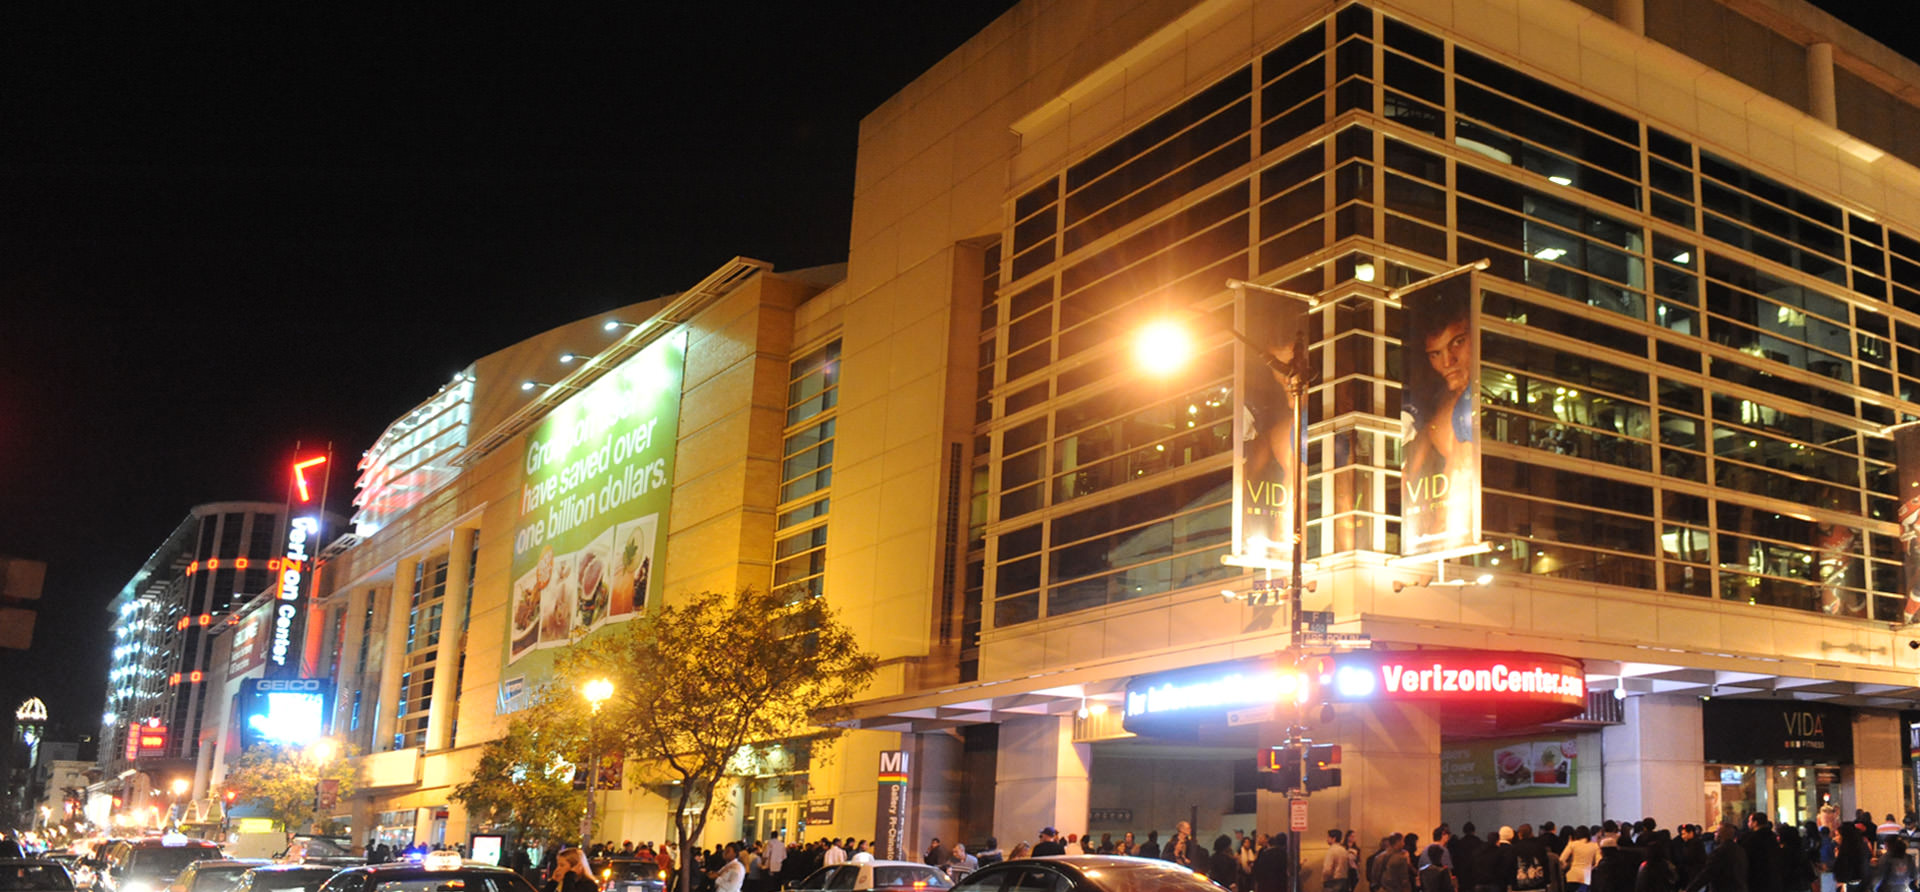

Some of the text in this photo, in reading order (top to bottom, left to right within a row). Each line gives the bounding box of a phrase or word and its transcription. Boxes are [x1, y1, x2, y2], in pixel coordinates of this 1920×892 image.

[521, 416, 658, 516] have saved over
[1247, 480, 1287, 508] VID
[1406, 473, 1449, 504] VID
[516, 457, 667, 555] one billion dollars.
[272, 517, 318, 666] Verizon Center
[256, 679, 320, 691] GEICO
[1381, 663, 1584, 698] VerizonCenter.com
[1783, 711, 1824, 737] VIDA
[880, 751, 901, 773] M
[887, 783, 900, 815] Gallery
